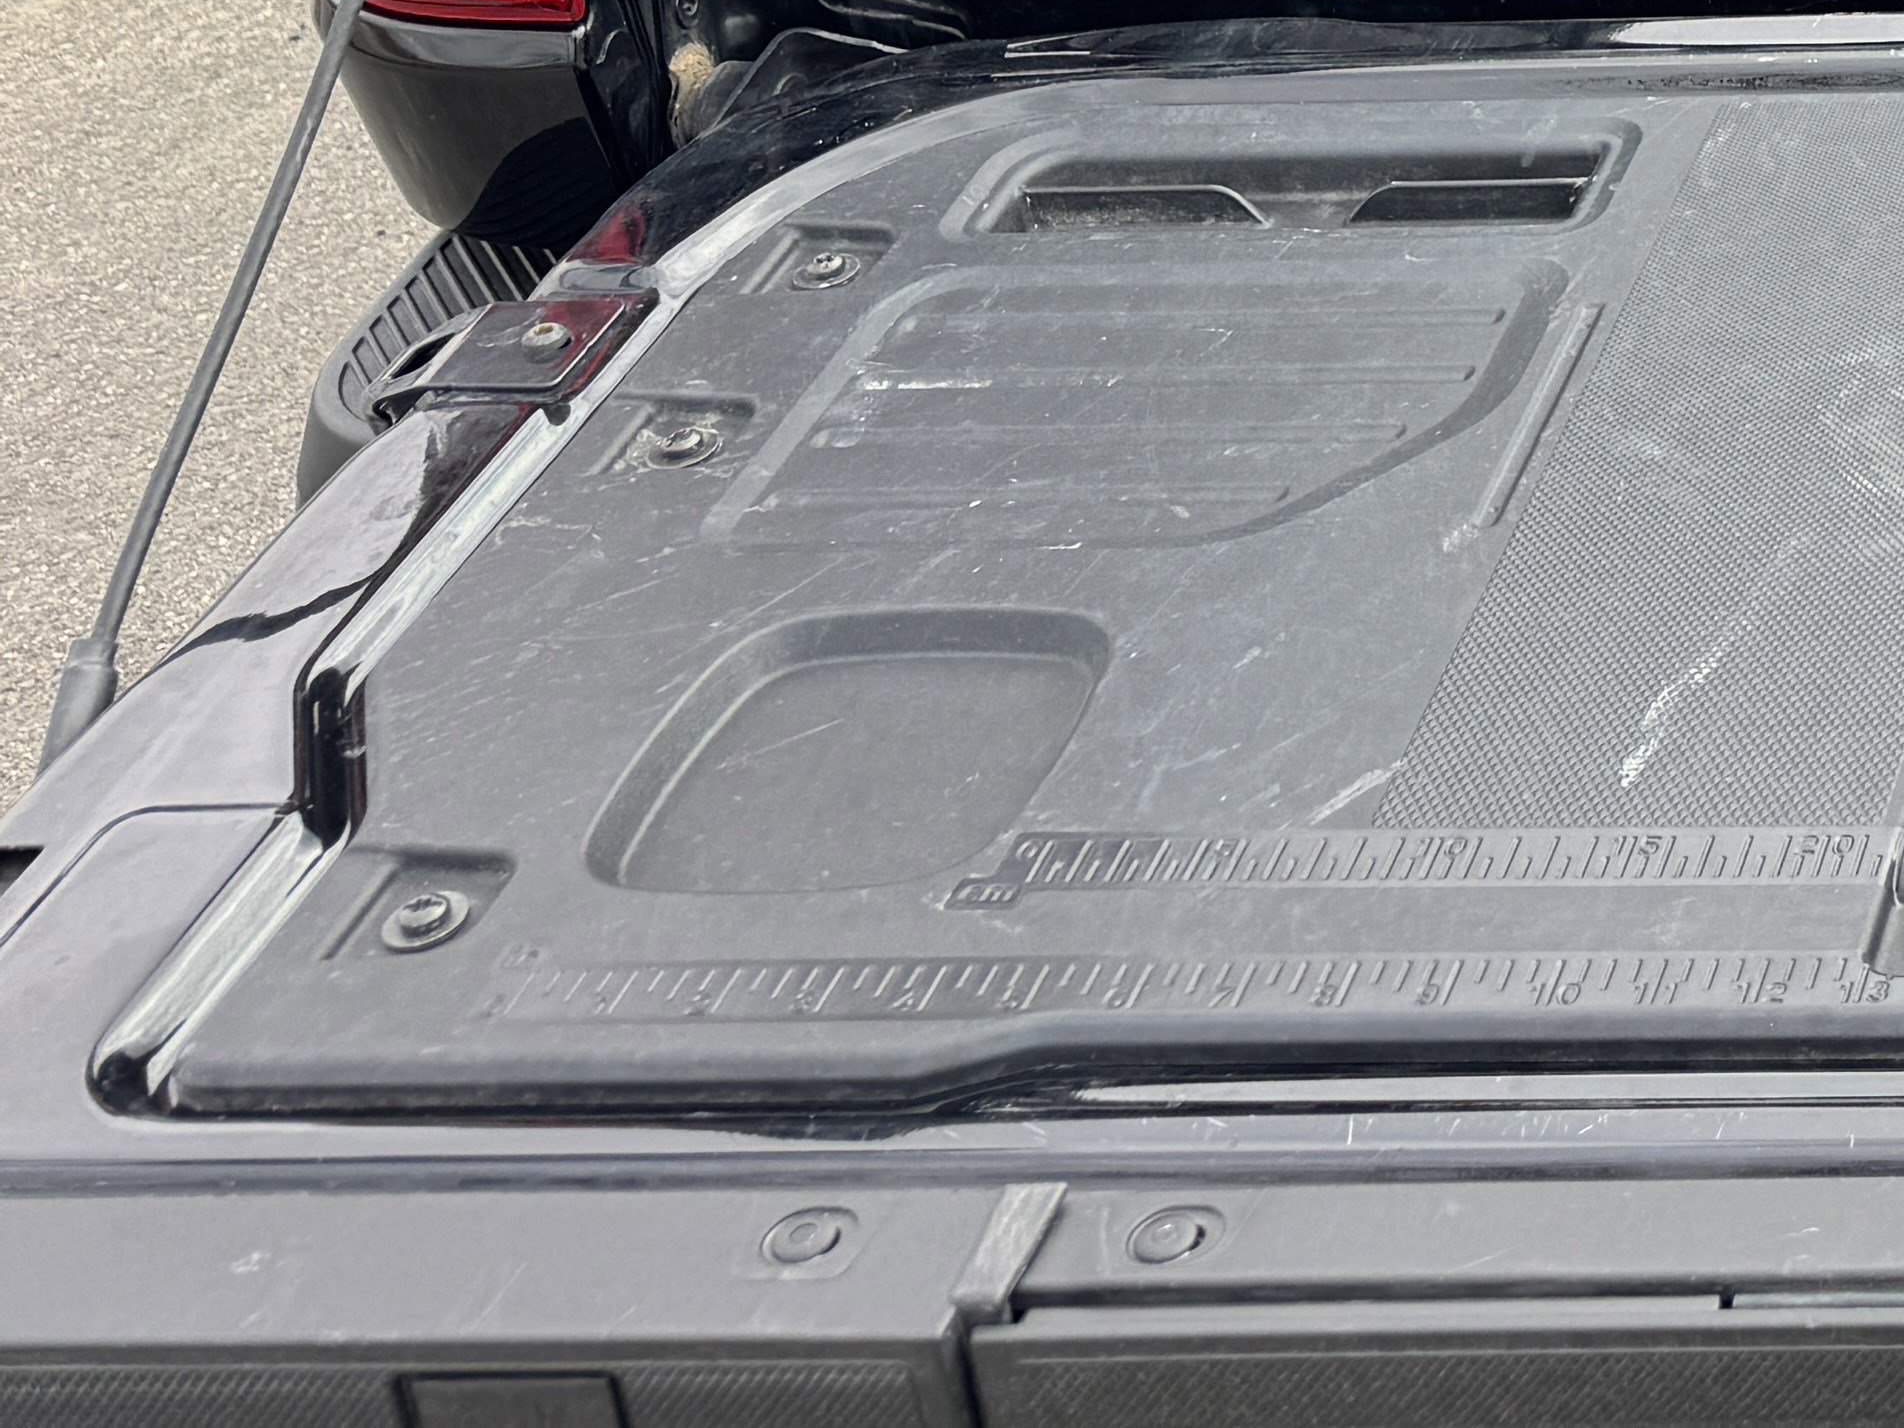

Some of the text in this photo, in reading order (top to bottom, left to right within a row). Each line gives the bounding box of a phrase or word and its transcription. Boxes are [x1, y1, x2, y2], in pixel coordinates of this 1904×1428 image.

[1615, 835, 1662, 856] 15
[1798, 834, 1855, 855] 20
[1310, 984, 1338, 1007] 8
[1416, 983, 1440, 1006] 9
[1530, 982, 1582, 1006] 10
[1633, 982, 1681, 1005] 11
[1737, 982, 1787, 1004] 12
[1840, 981, 1889, 1004] 13
